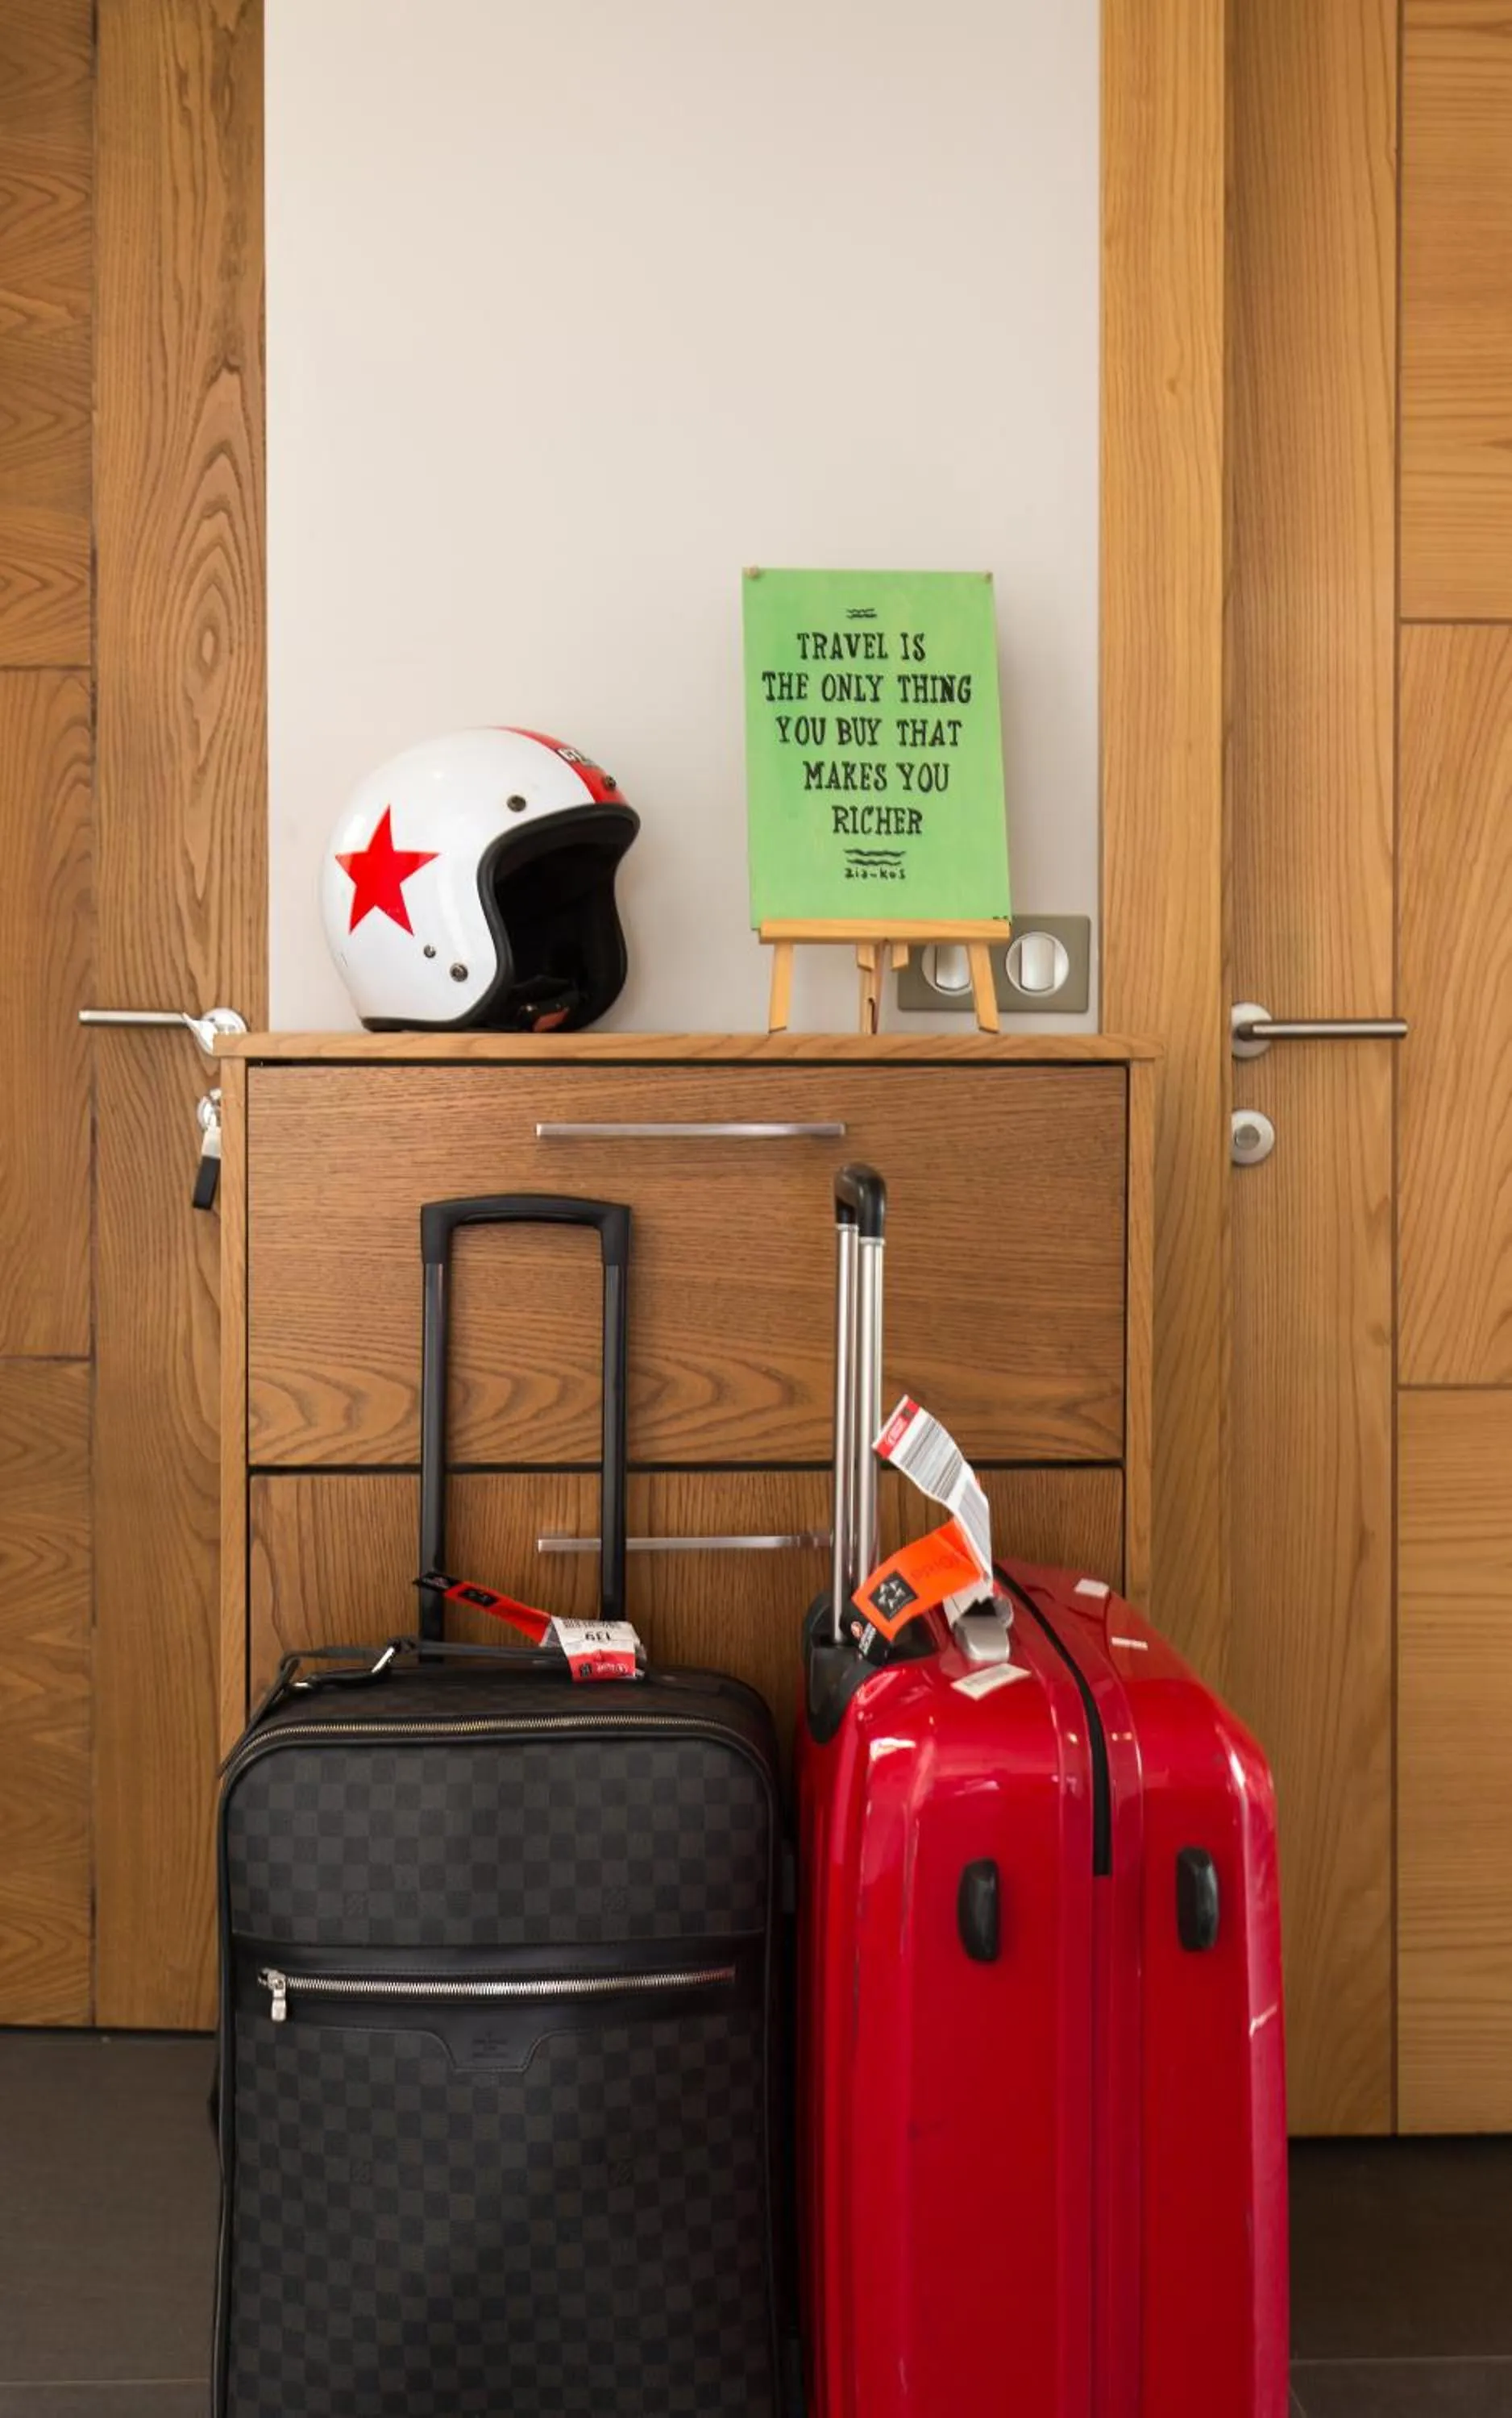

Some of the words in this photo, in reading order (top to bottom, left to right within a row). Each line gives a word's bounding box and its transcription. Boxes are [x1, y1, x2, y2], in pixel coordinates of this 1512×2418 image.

[796, 632, 888, 660] TRAVEL
[900, 632, 926, 662] IS
[762, 671, 808, 702] THE
[821, 673, 884, 704] ONLY
[897, 673, 972, 704] THING
[775, 716, 826, 746] YOU
[837, 717, 883, 747] BUY
[896, 718, 962, 748] THAT
[803, 760, 887, 791] MAKES
[895, 762, 949, 793] YOU
[831, 805, 923, 836] RICHER
